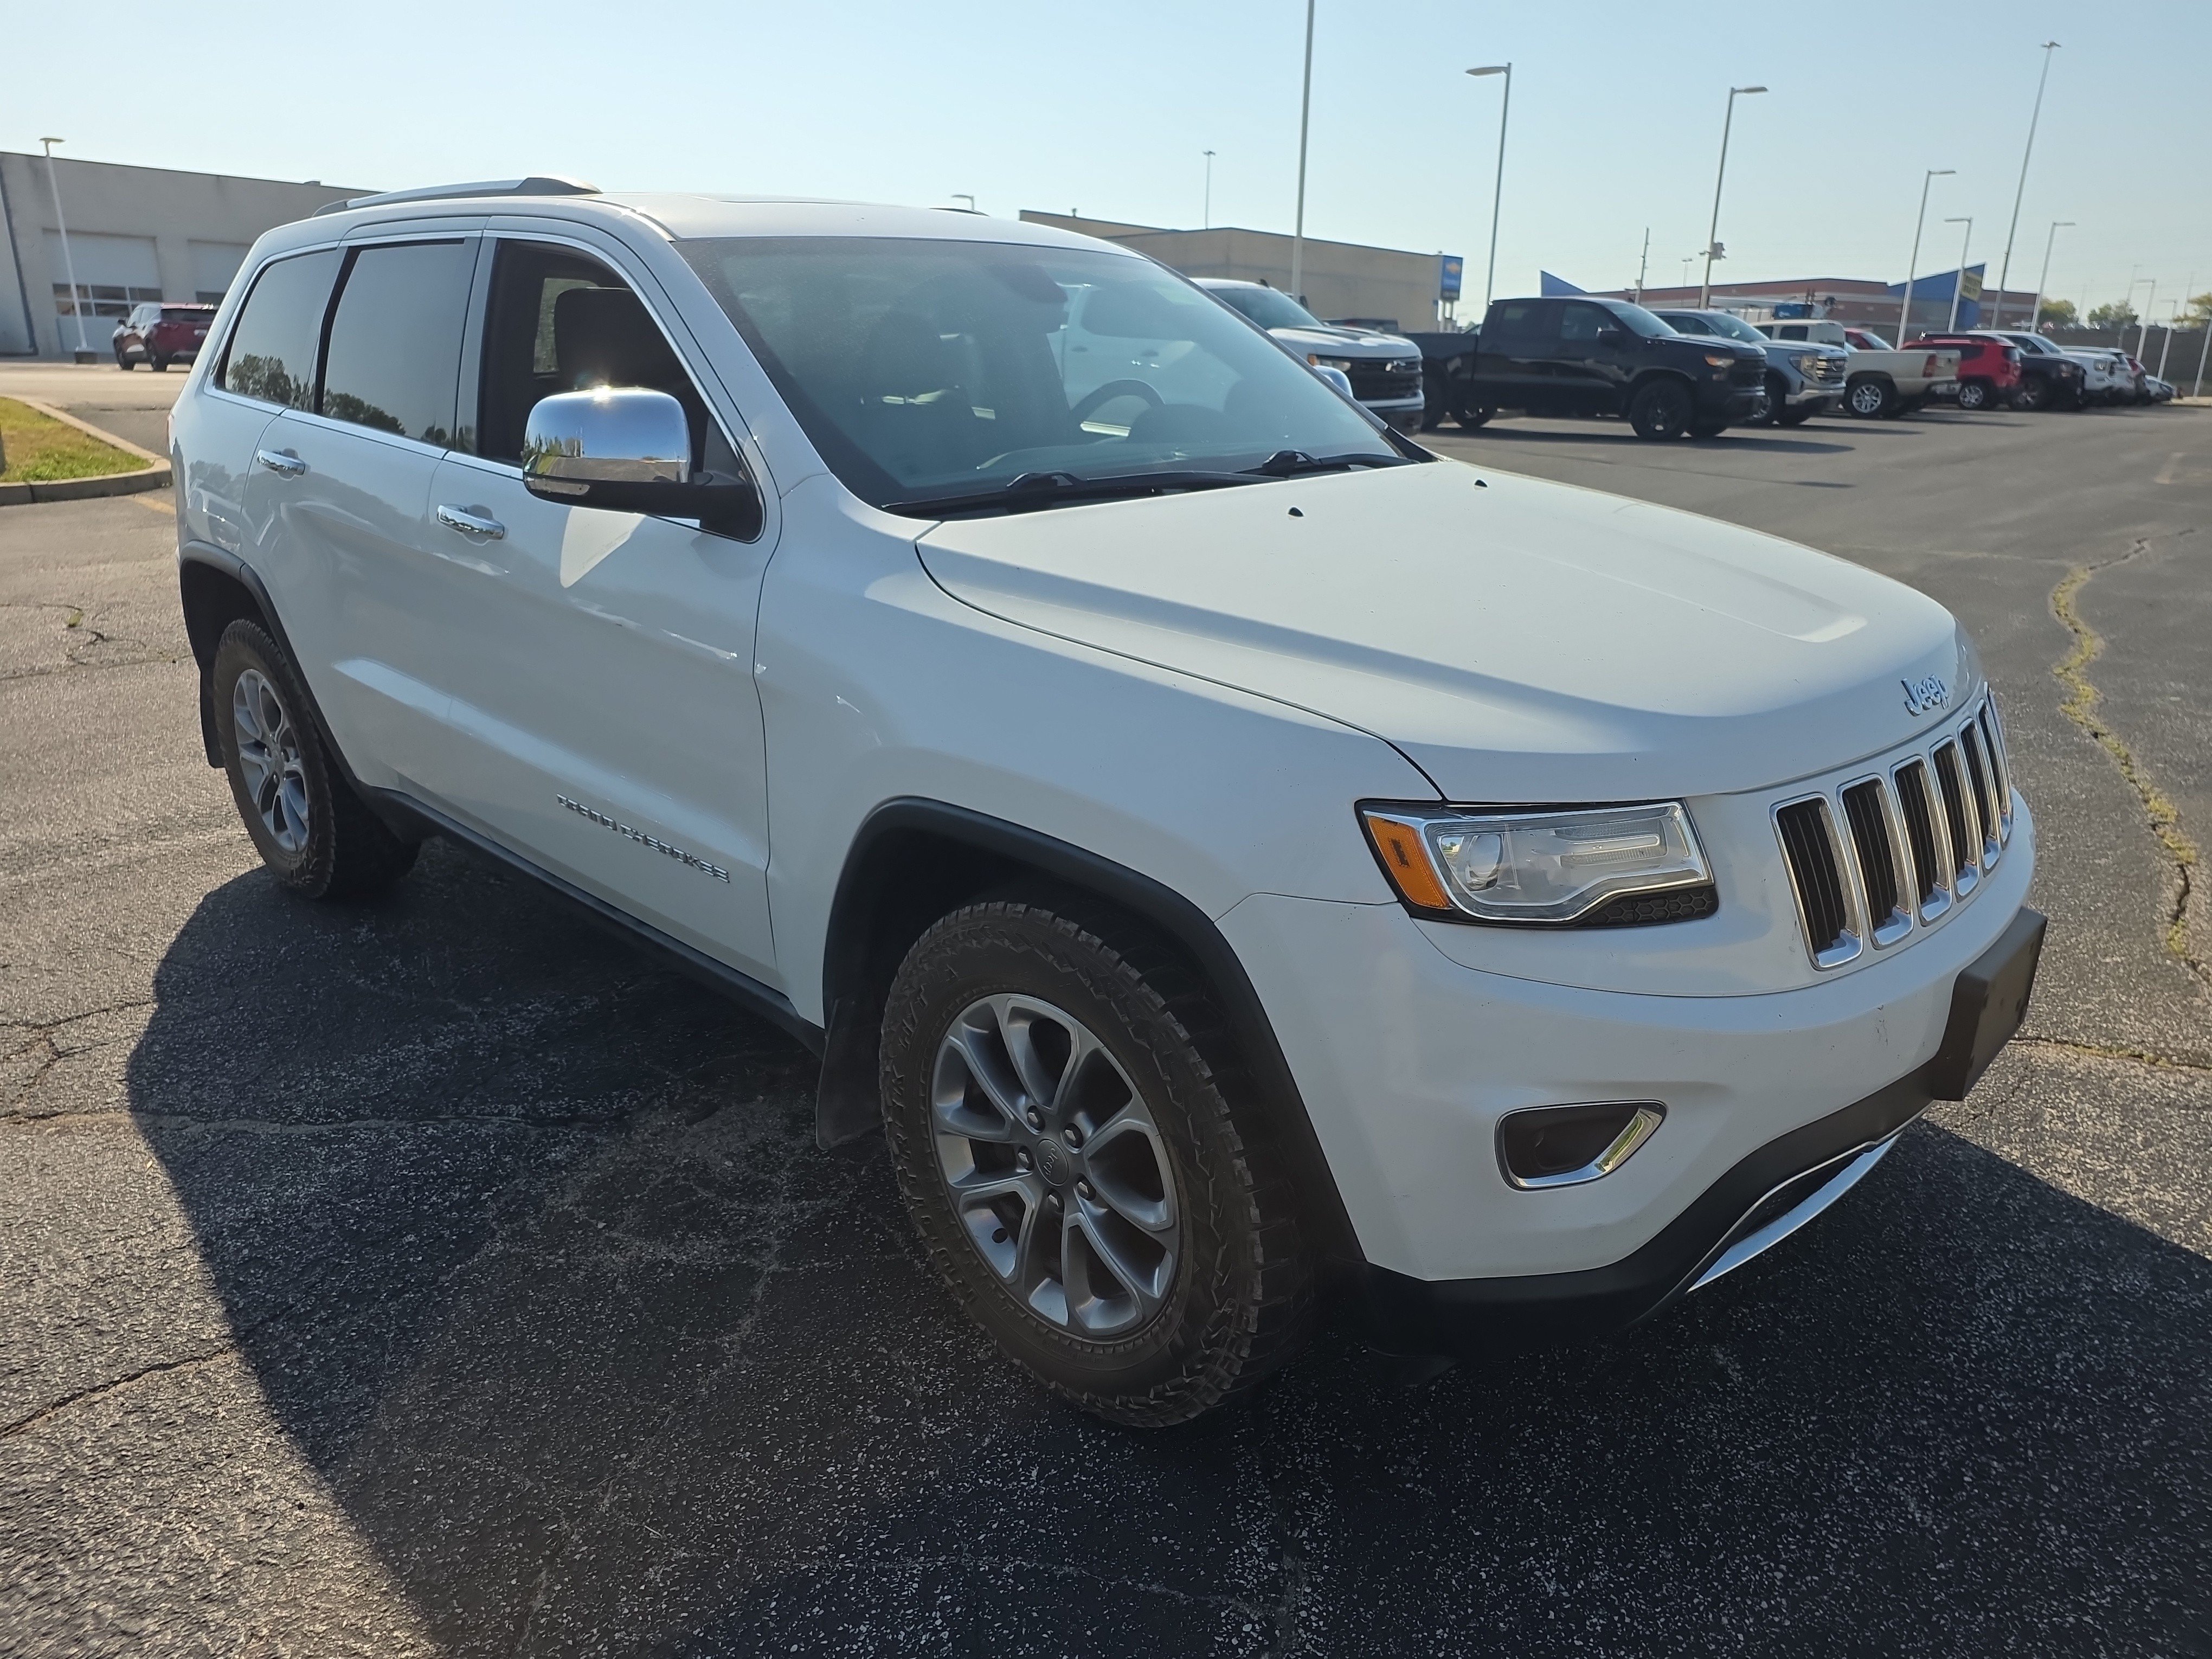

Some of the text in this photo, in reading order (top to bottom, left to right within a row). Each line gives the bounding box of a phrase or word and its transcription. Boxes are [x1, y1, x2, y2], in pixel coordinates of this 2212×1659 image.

[1901, 675, 1949, 716] Jeep
[556, 793, 730, 883] GRAND CHEROKEE
[1043, 1148, 1058, 1176] Jeep
